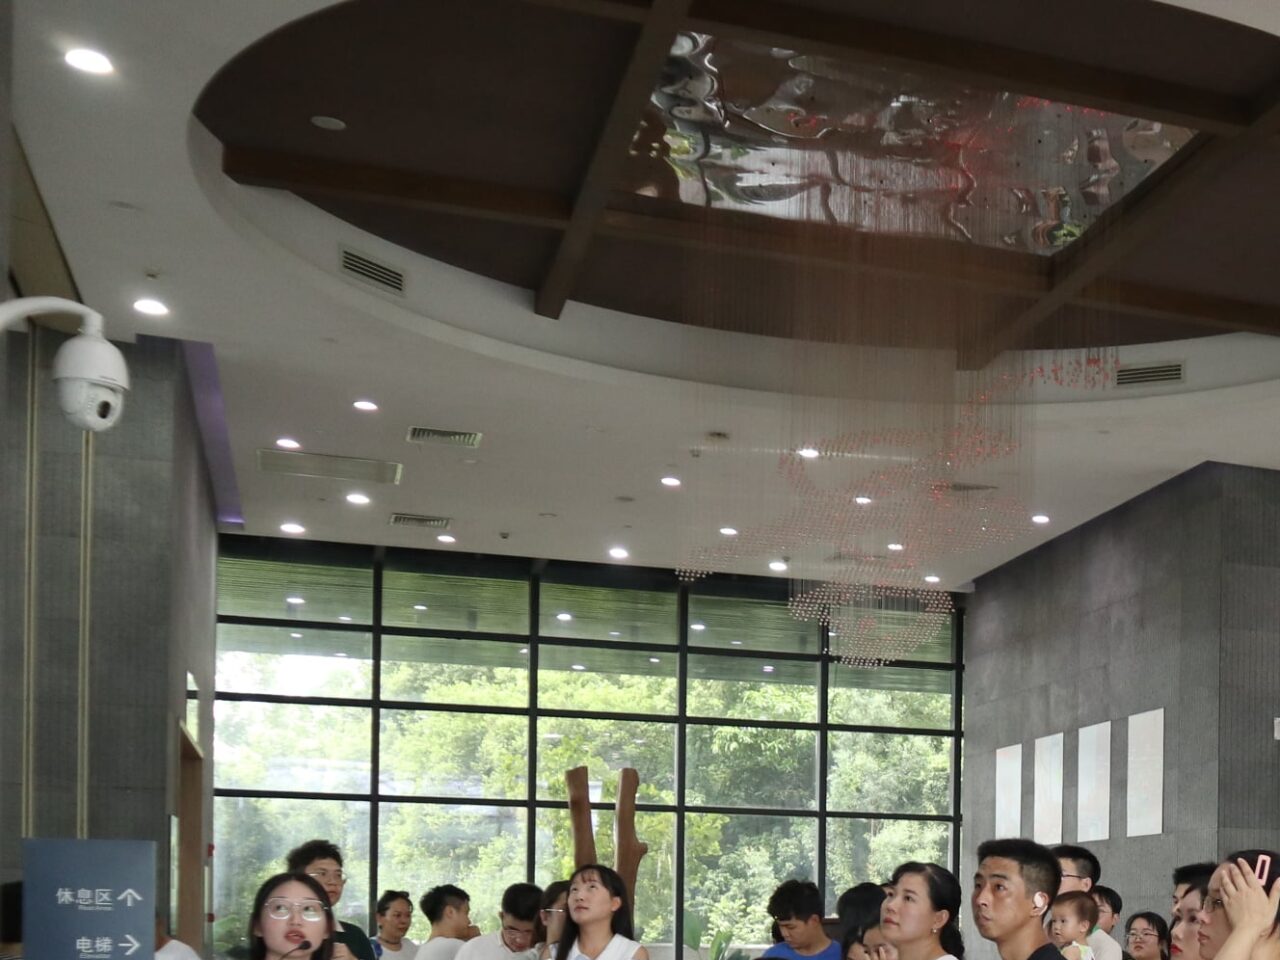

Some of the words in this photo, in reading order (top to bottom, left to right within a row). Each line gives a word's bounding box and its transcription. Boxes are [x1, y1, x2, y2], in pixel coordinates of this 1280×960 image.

[56, 887, 113, 905] 休息区
[76, 936, 113, 953] 电梯
